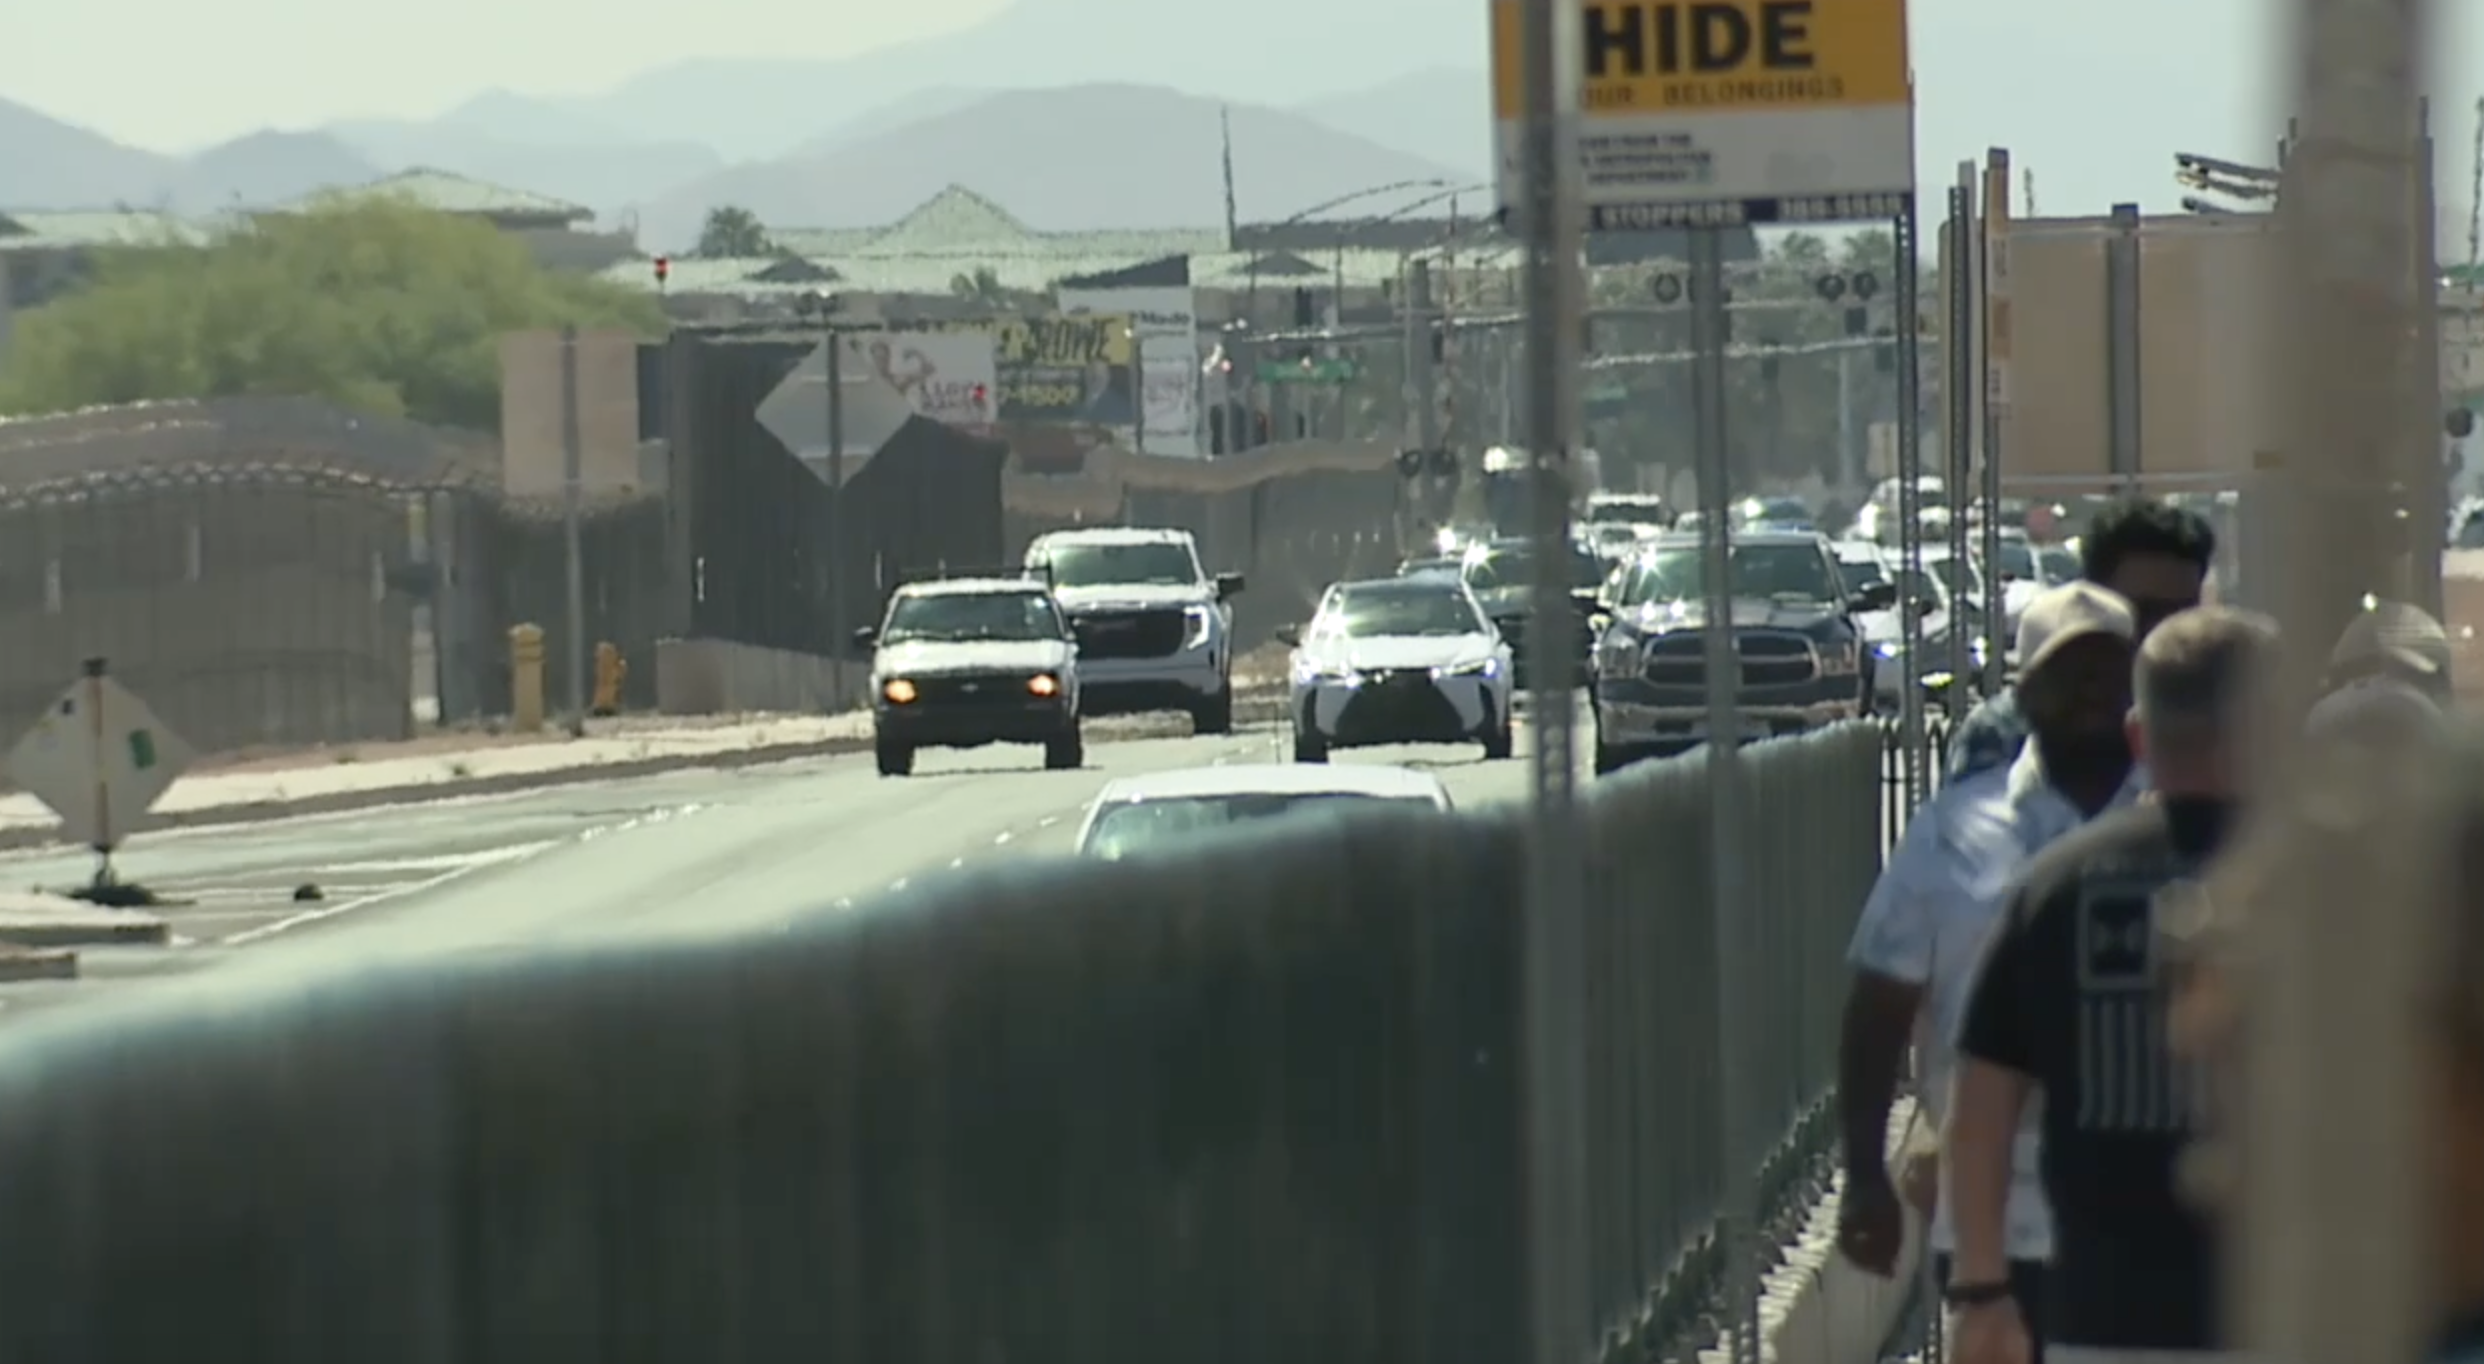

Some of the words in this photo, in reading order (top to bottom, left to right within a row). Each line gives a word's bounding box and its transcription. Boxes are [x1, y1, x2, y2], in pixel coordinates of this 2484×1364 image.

[1584, 2, 1814, 76] HIDE
[1664, 76, 1845, 106] BELONGINGS
[1600, 201, 1744, 230] STOPPERS
